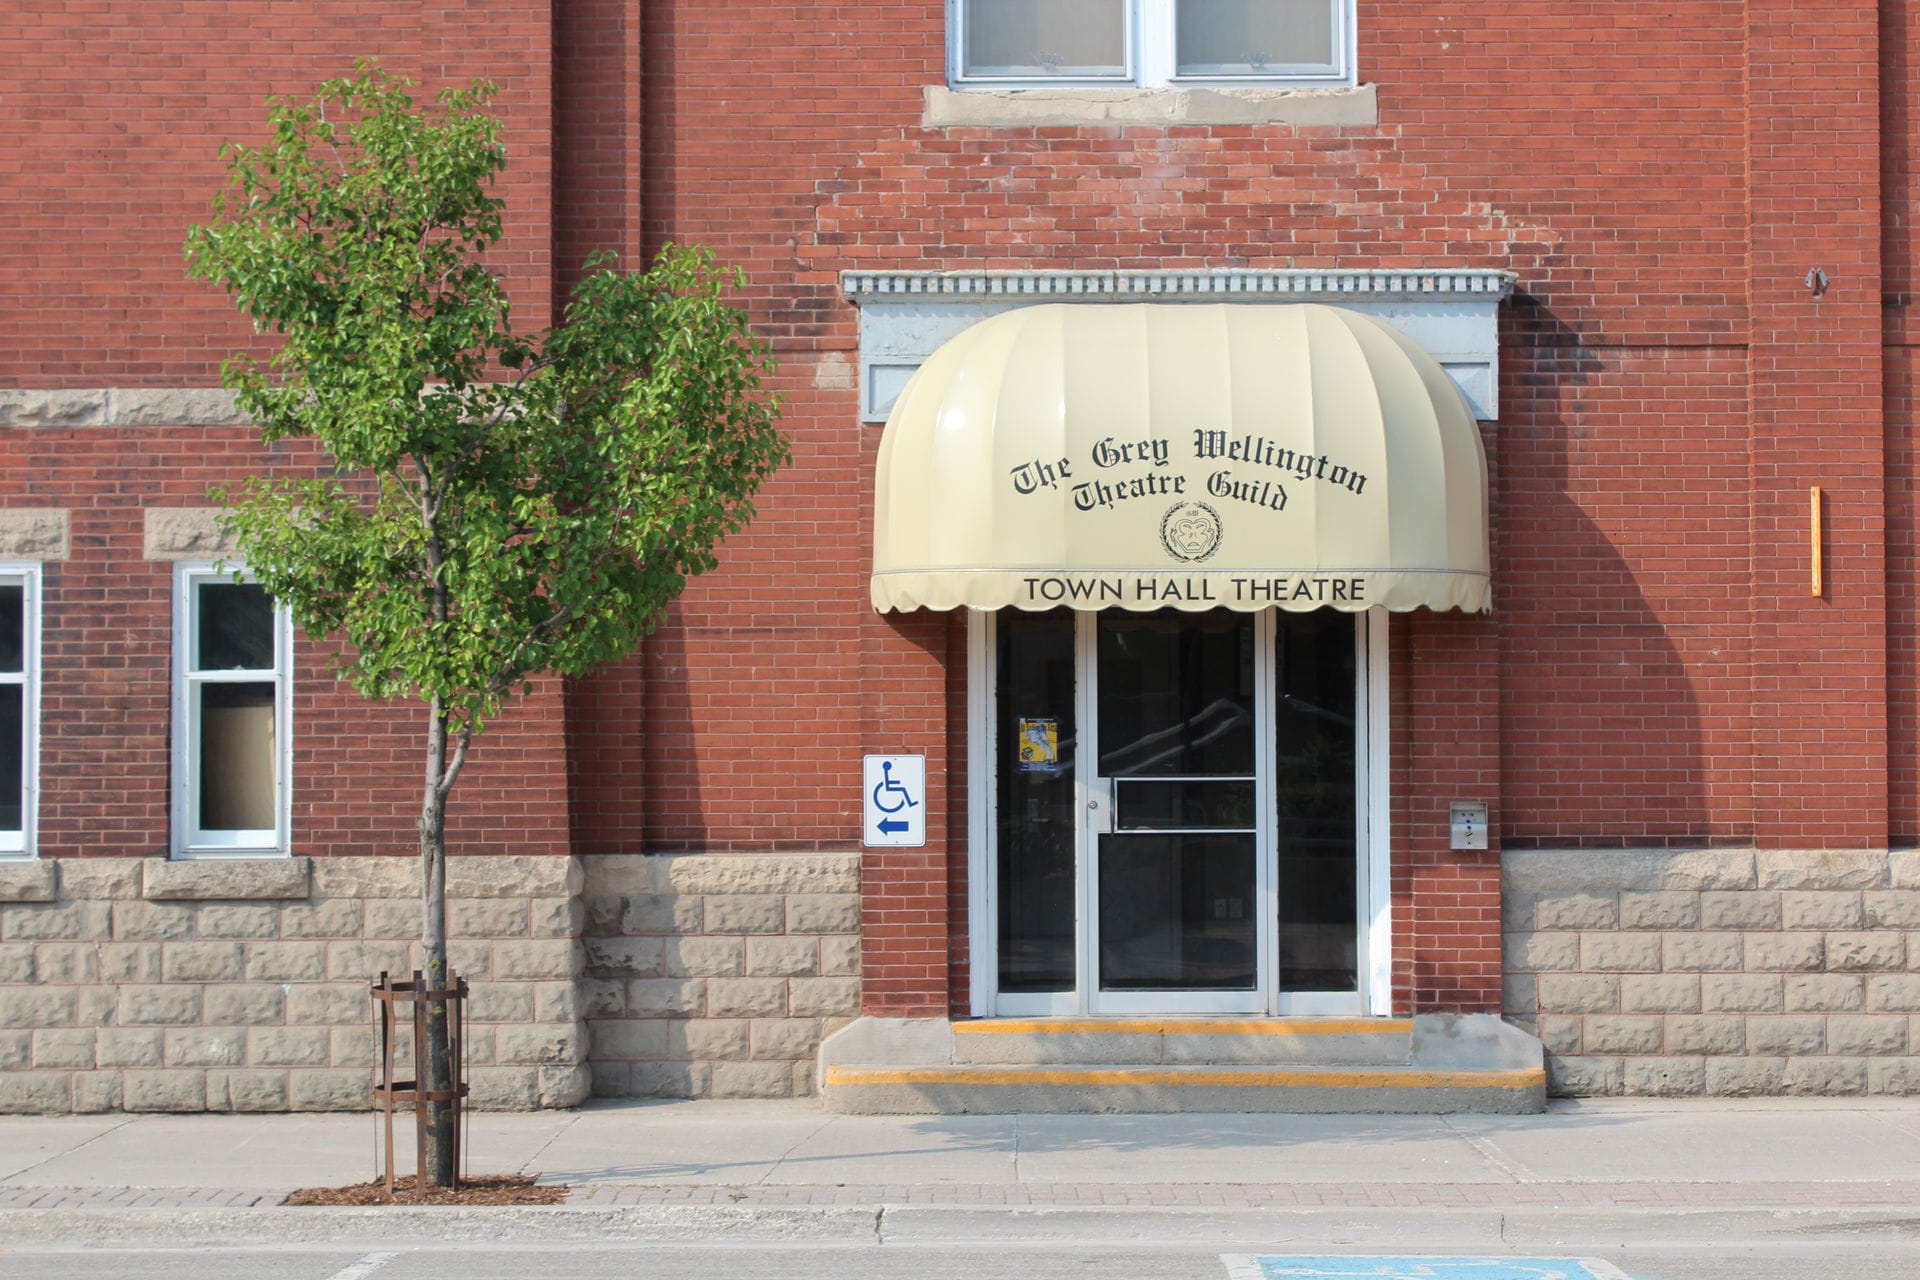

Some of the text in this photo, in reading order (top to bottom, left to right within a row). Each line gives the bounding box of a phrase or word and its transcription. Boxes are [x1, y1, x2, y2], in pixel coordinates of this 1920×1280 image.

[1010, 428, 1368, 496] The Grey Wellington
[1071, 470, 1288, 511] Theatre Guild
[1024, 578, 1365, 601] TOWN HALL THEATRE
